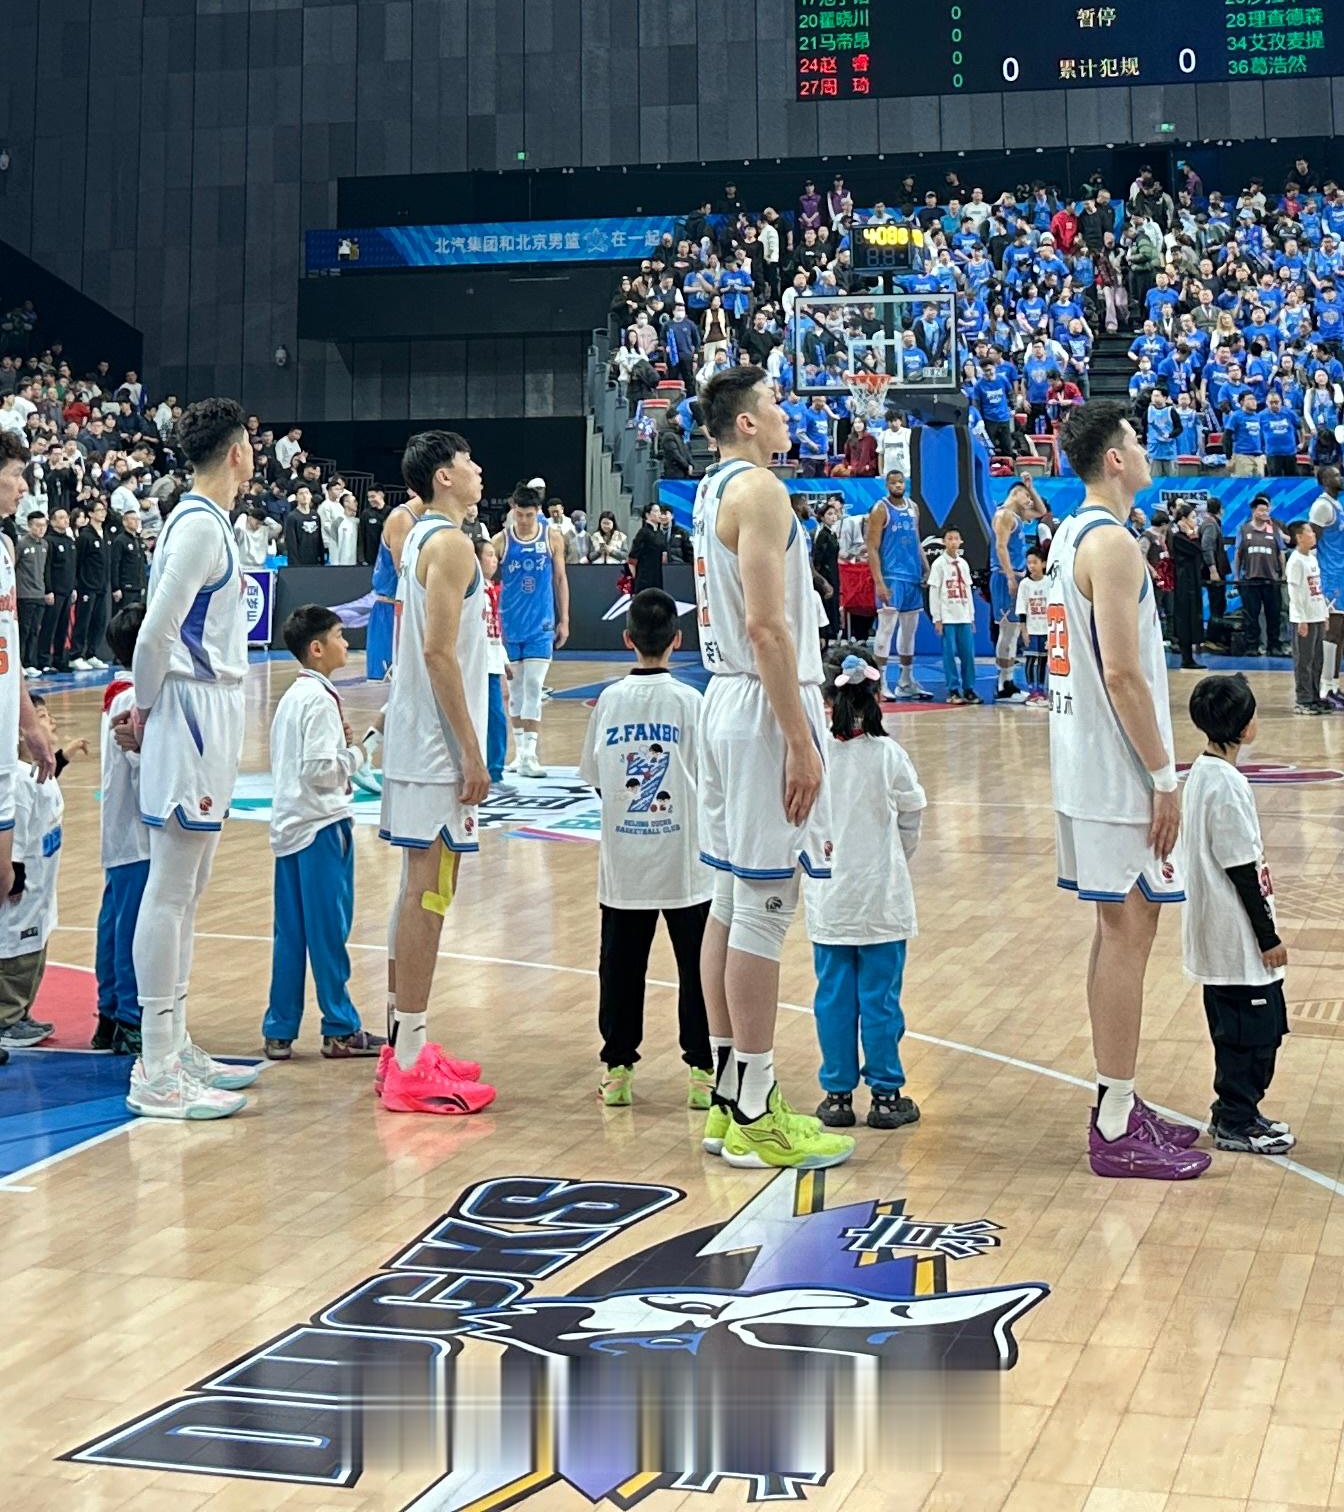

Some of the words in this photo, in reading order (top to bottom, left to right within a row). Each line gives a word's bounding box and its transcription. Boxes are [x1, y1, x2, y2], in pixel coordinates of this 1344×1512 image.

[951, 6, 961, 20] 0
[1076, 6, 1117, 28] 暂停
[952, 28, 962, 42] 0
[952, 50, 963, 65] 0
[1058, 56, 1141, 79] 累计犯规
[1178, 47, 1196, 74] 0
[953, 73, 963, 88] 0
[1002, 57, 1020, 82] 0
[434, 233, 581, 256] 北汽集团和北京男篮
[610, 230, 660, 249] 在一起
